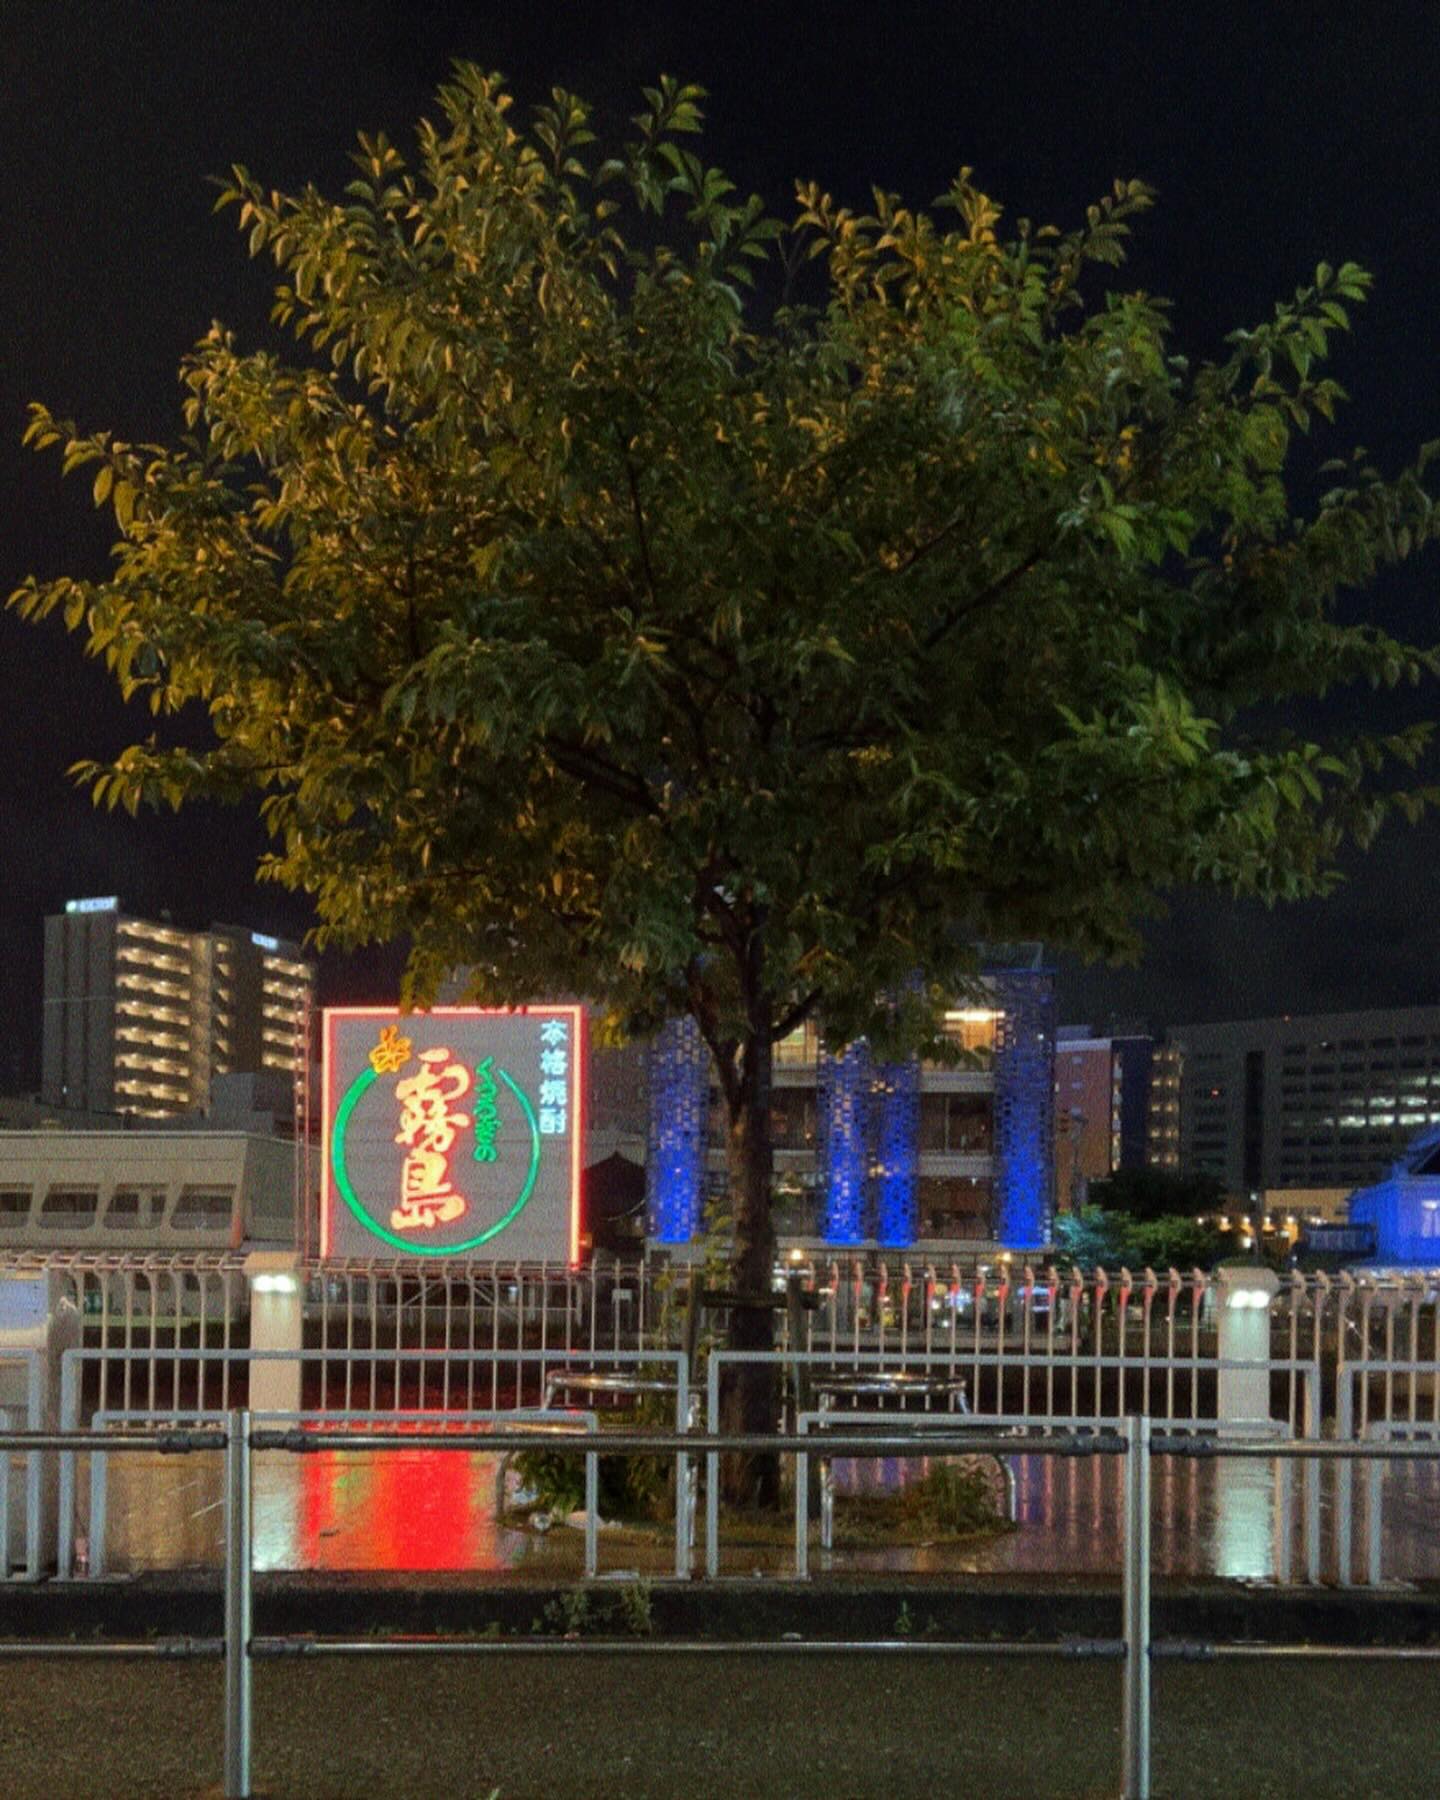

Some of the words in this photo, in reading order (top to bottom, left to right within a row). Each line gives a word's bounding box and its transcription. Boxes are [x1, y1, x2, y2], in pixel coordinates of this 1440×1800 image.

[390, 1048, 470, 1230] 霧島
[539, 1019, 567, 1134] 本格焼酎
